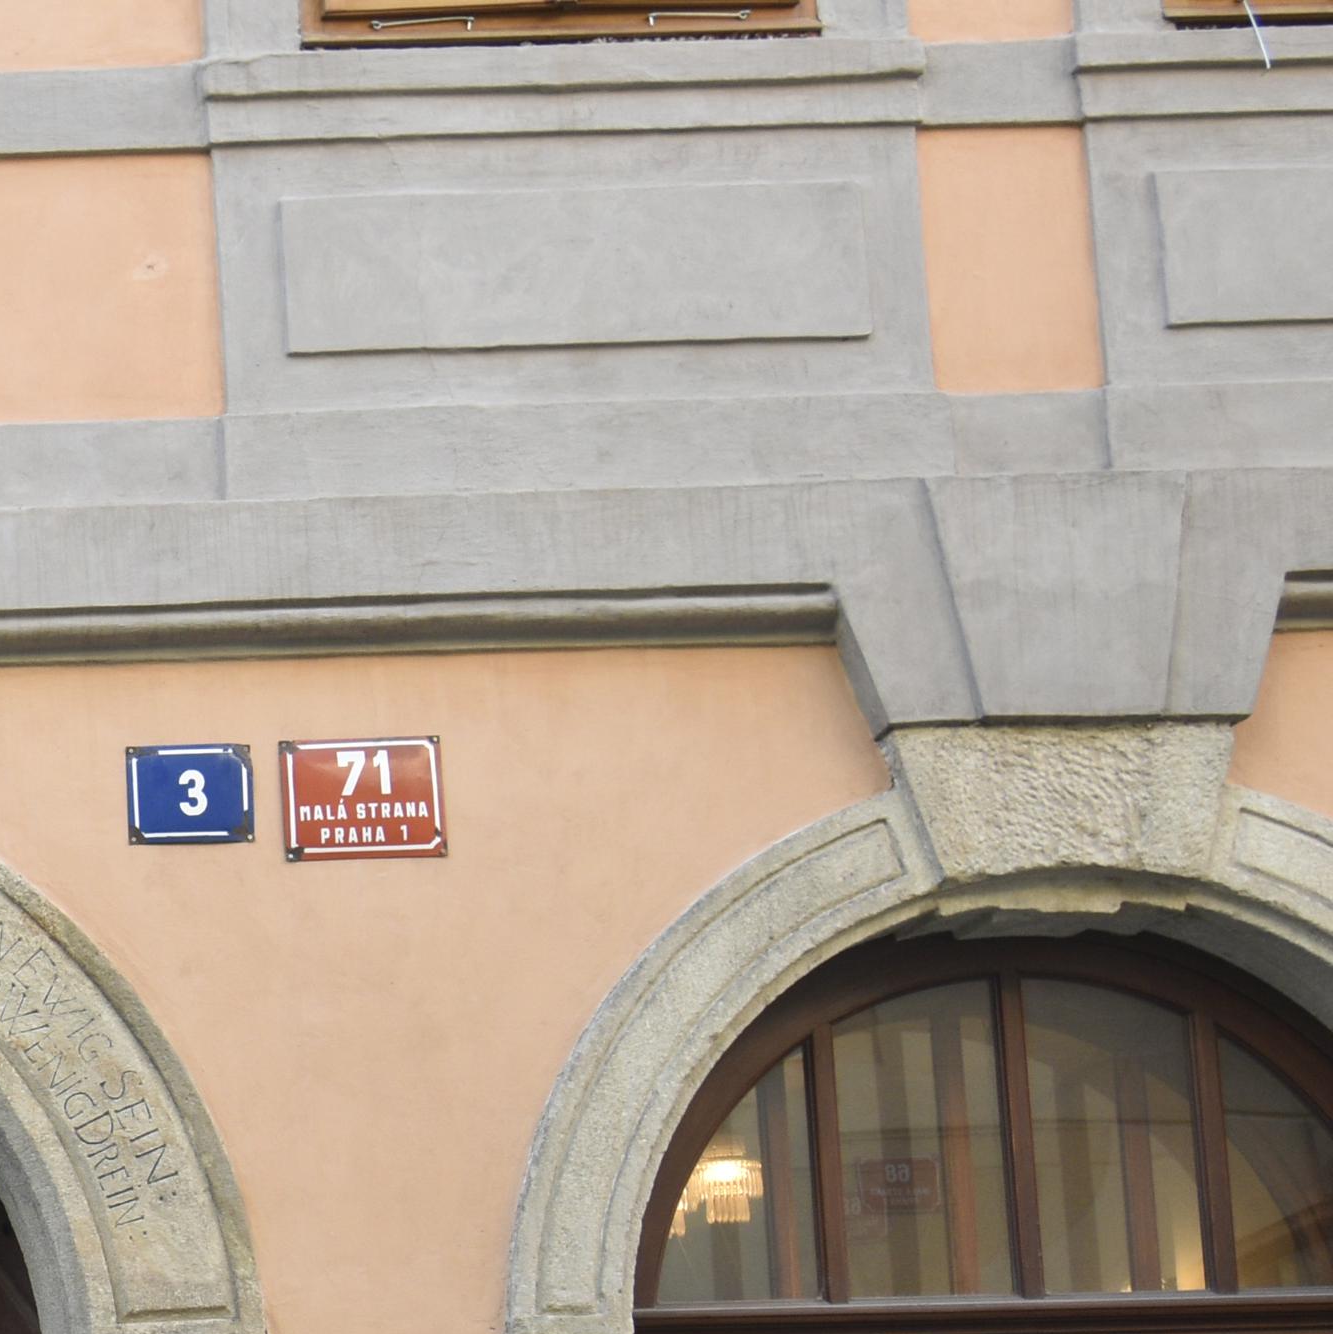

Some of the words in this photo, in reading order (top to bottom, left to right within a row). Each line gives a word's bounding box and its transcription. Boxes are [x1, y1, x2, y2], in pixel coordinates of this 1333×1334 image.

[336, 749, 392, 796] 71
[179, 769, 208, 816] 3
[299, 799, 347, 821] MALÁ
[356, 801, 428, 819] STRANA
[320, 825, 386, 844] PRAHA
[400, 824, 408, 841] 1
